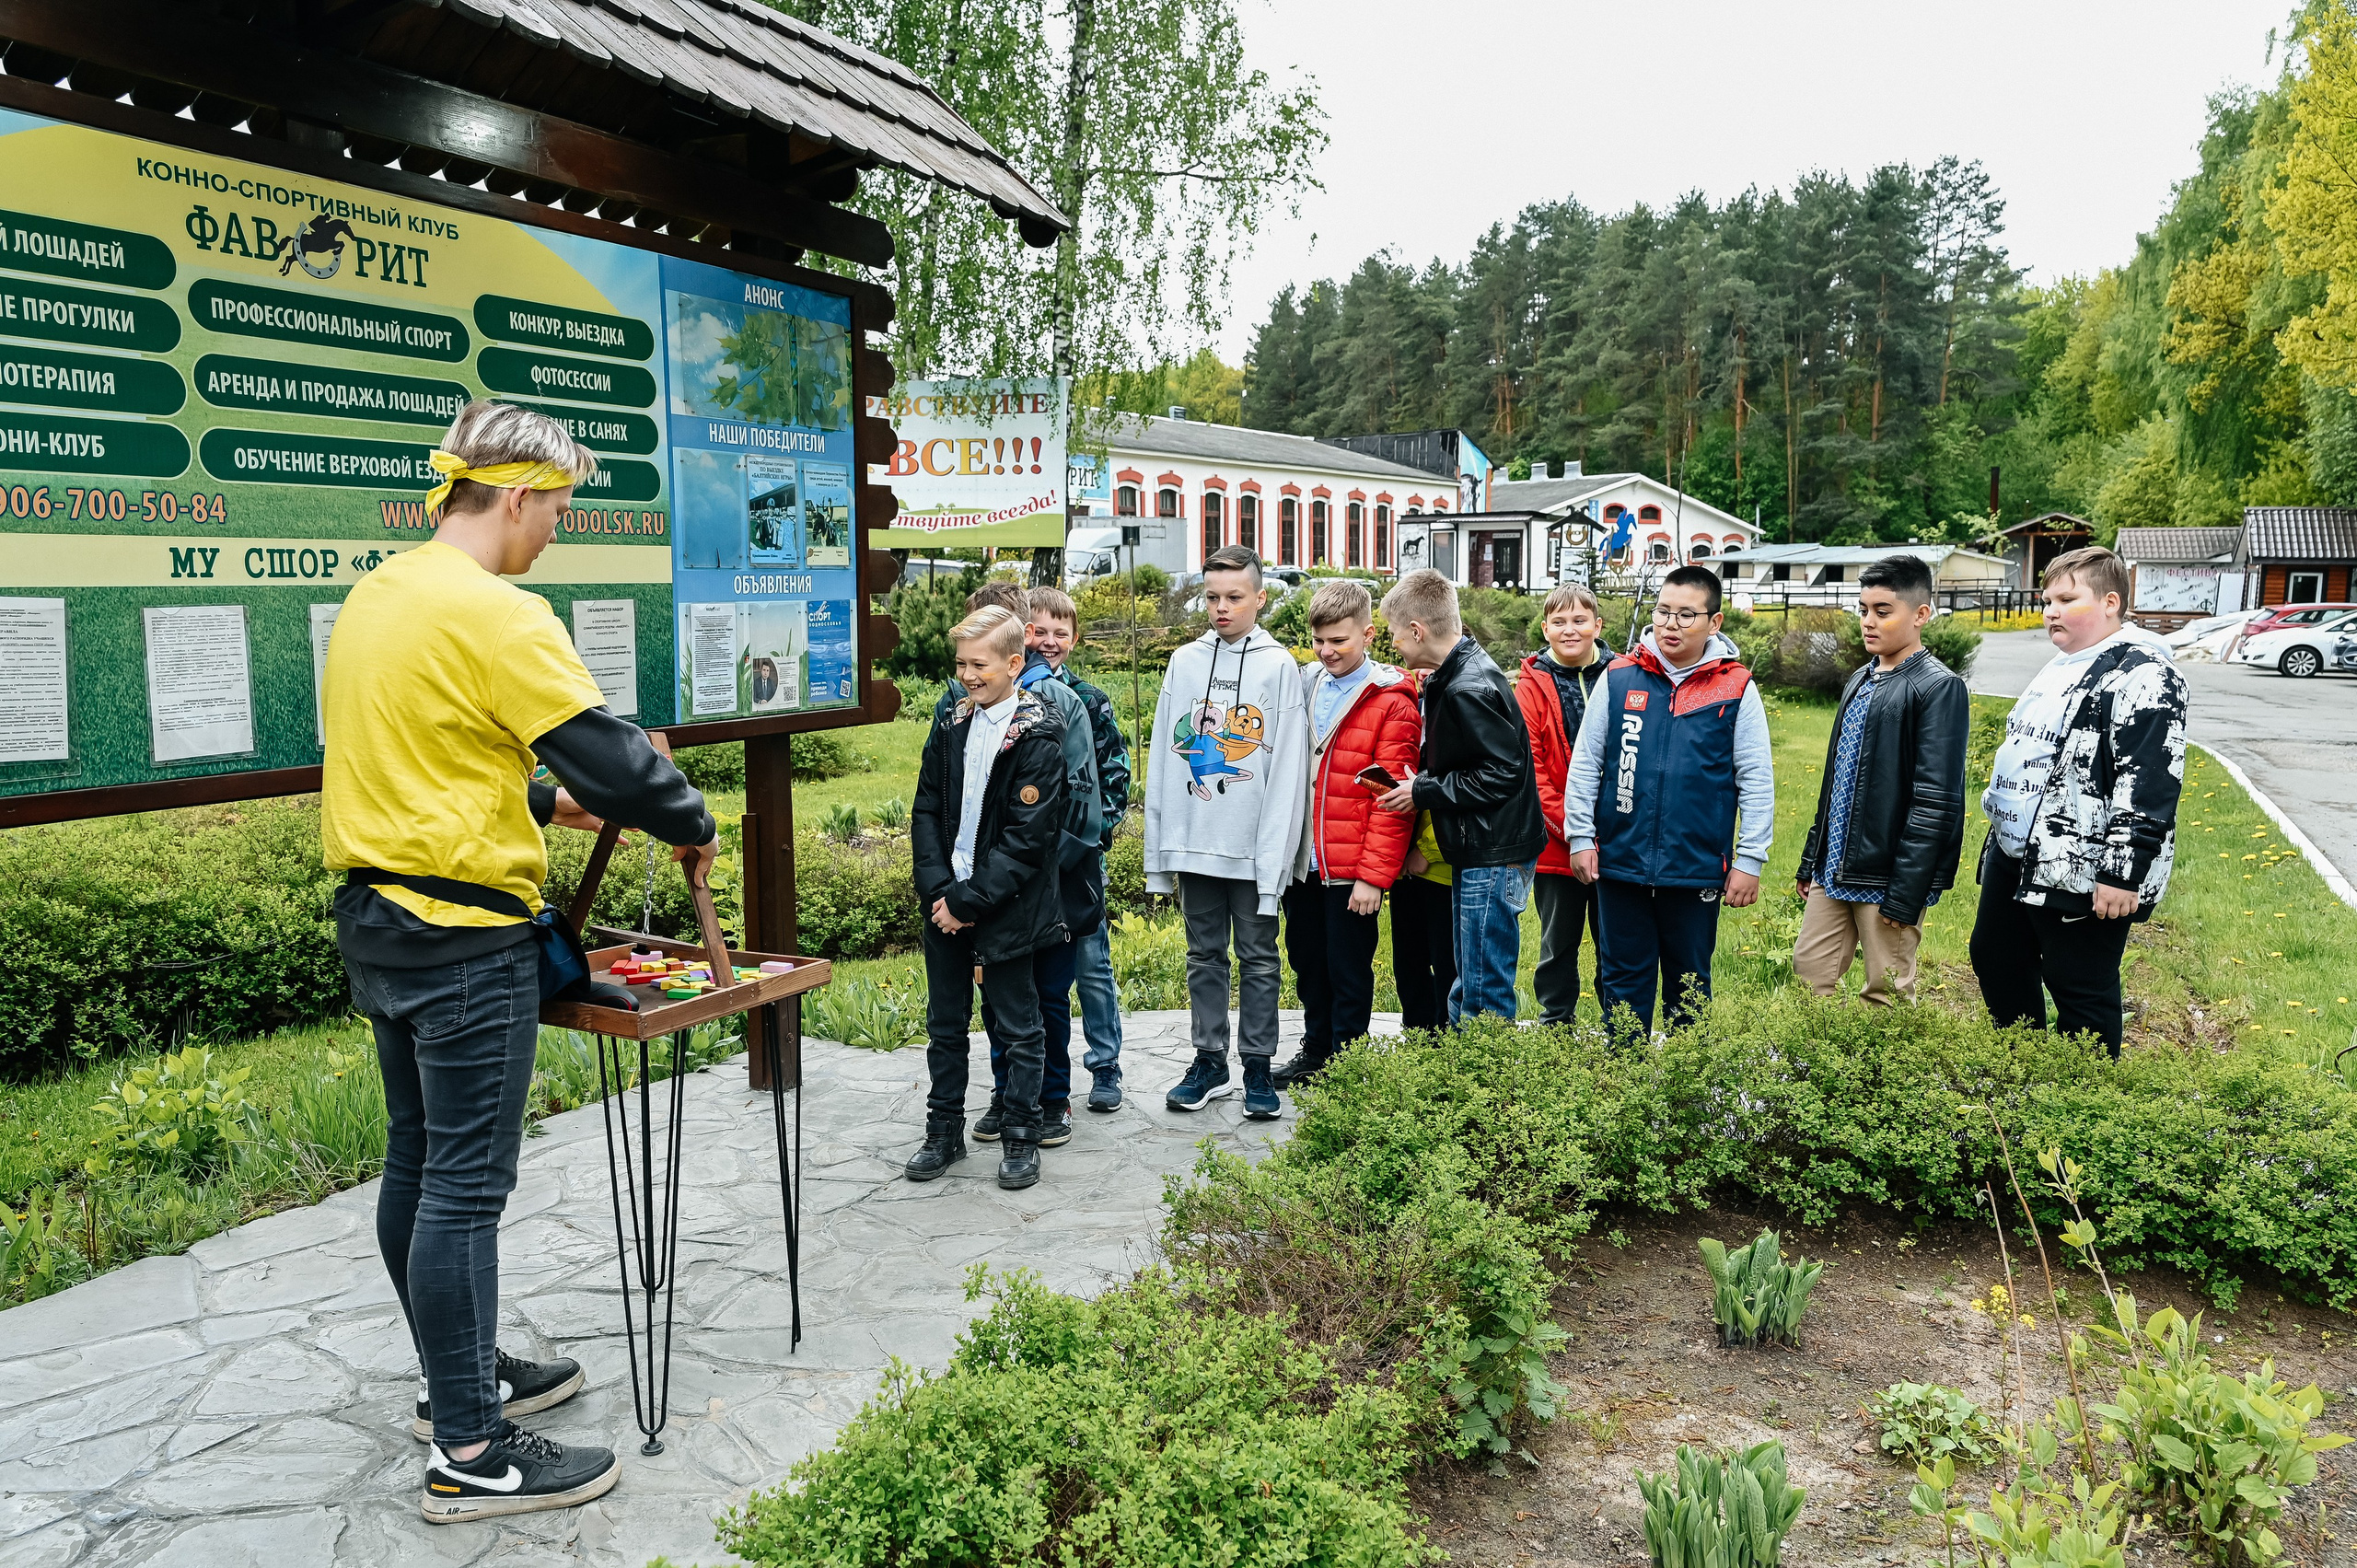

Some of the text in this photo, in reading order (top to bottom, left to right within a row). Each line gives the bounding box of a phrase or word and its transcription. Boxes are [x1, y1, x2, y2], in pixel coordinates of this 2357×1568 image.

[137, 157, 459, 240] КОННО-СПОРТИВНЫЙ КЛУБ
[14, 228, 125, 269] ЛОШАДЕЙ
[744, 283, 784, 310] АНОНС
[0, 294, 135, 333] Е ПРОГУЛКИ
[211, 296, 452, 351] ПРОФЕССИОНАЛЬНЫЙ СПОРТ
[509, 311, 625, 347] КОНКУР, ВЫЕЗДКА
[0, 361, 116, 395] ОТЕРАПИЯ
[530, 365, 611, 392] ФОТОСЕССИИ
[208, 371, 464, 419] АРЕНДА И ПРОДАЖА ЛОШАДЕЙ
[578, 421, 586, 437] В
[589, 422, 628, 441] САНЯХ
[709, 423, 825, 454] НАШИ ПОБЕДИТЕЛИ
[234, 447, 326, 473] ОБУЧЕНИЕ
[330, 454, 412, 478] ВЕРХОВОЙ
[556, 507, 665, 536] ODOLSK.RU
[987, 489, 1058, 524] всегда!
[169, 547, 220, 578] МУ
[244, 547, 340, 578] СШОР
[734, 575, 813, 594] ОБЪЯВЛЕНИЯ
[1616, 714, 1643, 814] RUSSIA
[1996, 774, 2017, 790] Palm
[446, 1507, 460, 1516] AIR
